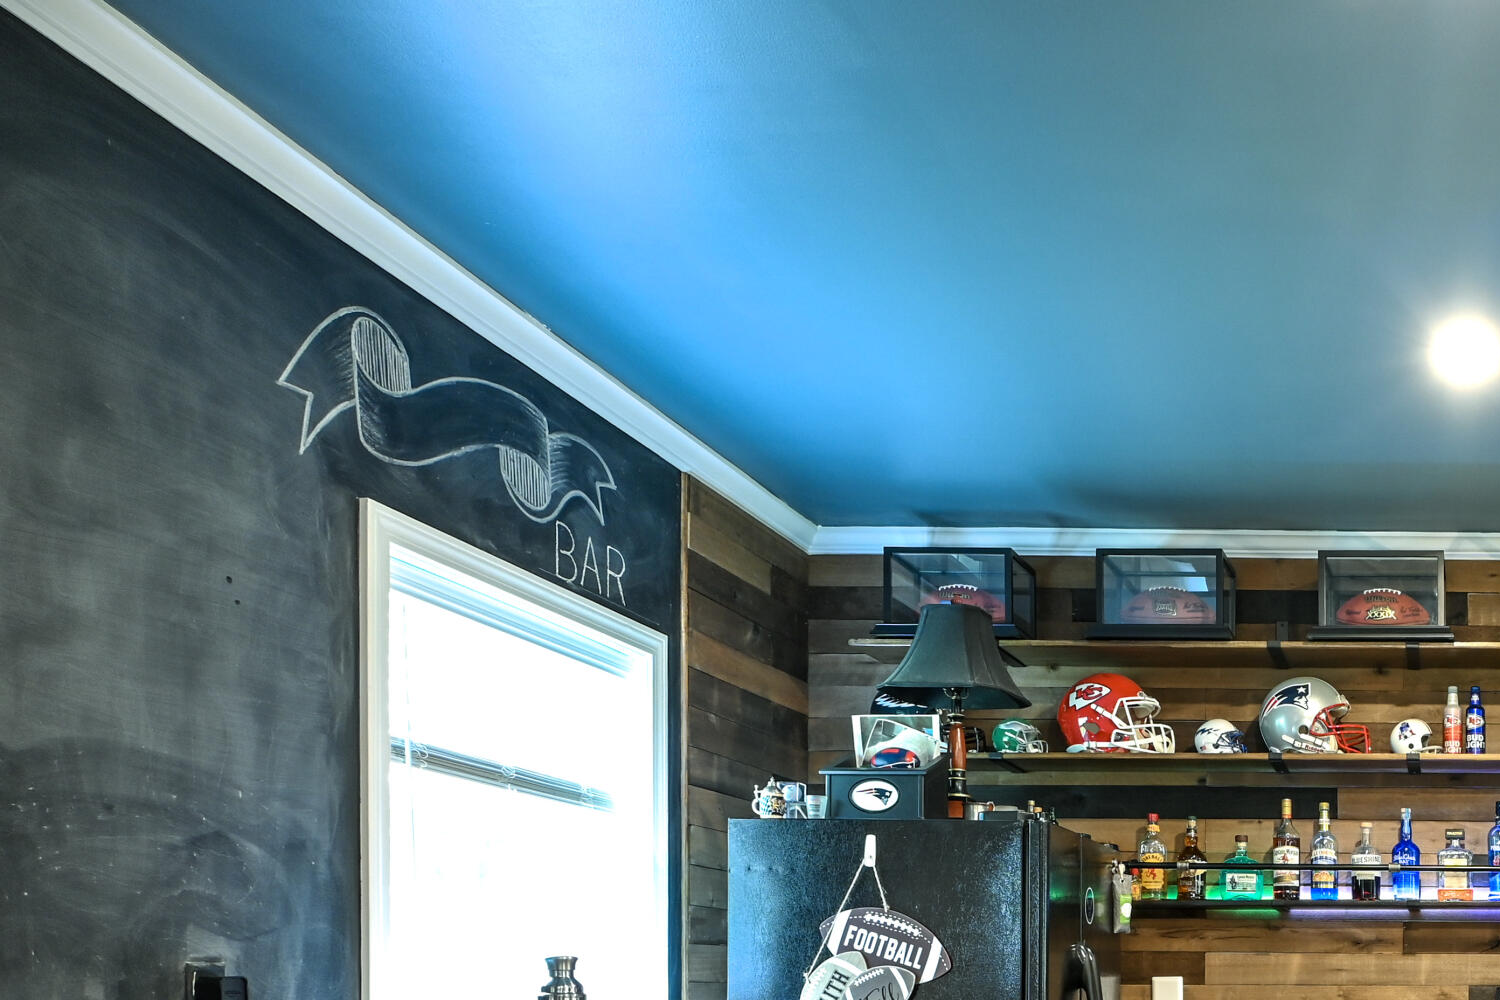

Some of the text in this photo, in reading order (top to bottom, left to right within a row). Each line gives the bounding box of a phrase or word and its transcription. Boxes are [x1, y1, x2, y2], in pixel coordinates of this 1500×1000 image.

[555, 520, 627, 606] BAR
[1466, 734, 1484, 742] BUD
[843, 925, 924, 970] FOOTBALL
